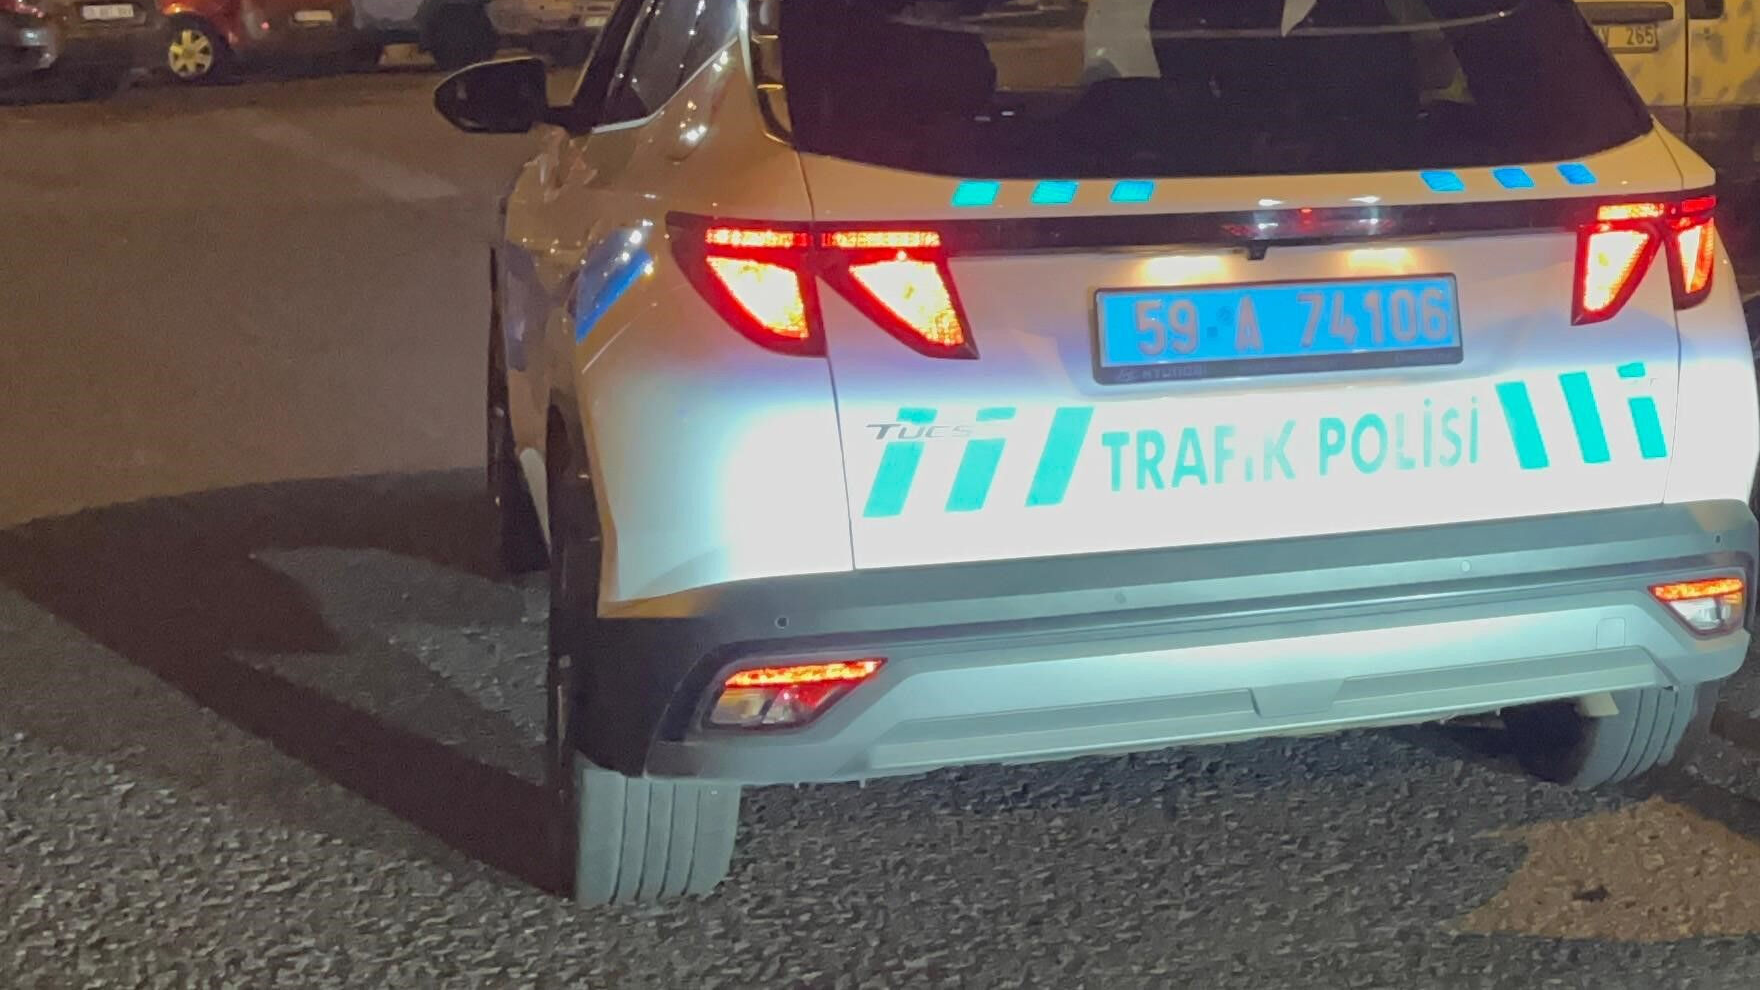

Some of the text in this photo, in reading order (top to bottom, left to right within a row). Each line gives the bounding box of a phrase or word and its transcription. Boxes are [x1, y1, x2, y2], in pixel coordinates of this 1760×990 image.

[1625, 26, 1655, 45] 265
[1133, 288, 1449, 356] 59 A 74106
[1318, 395, 1480, 477] POLİSİ
